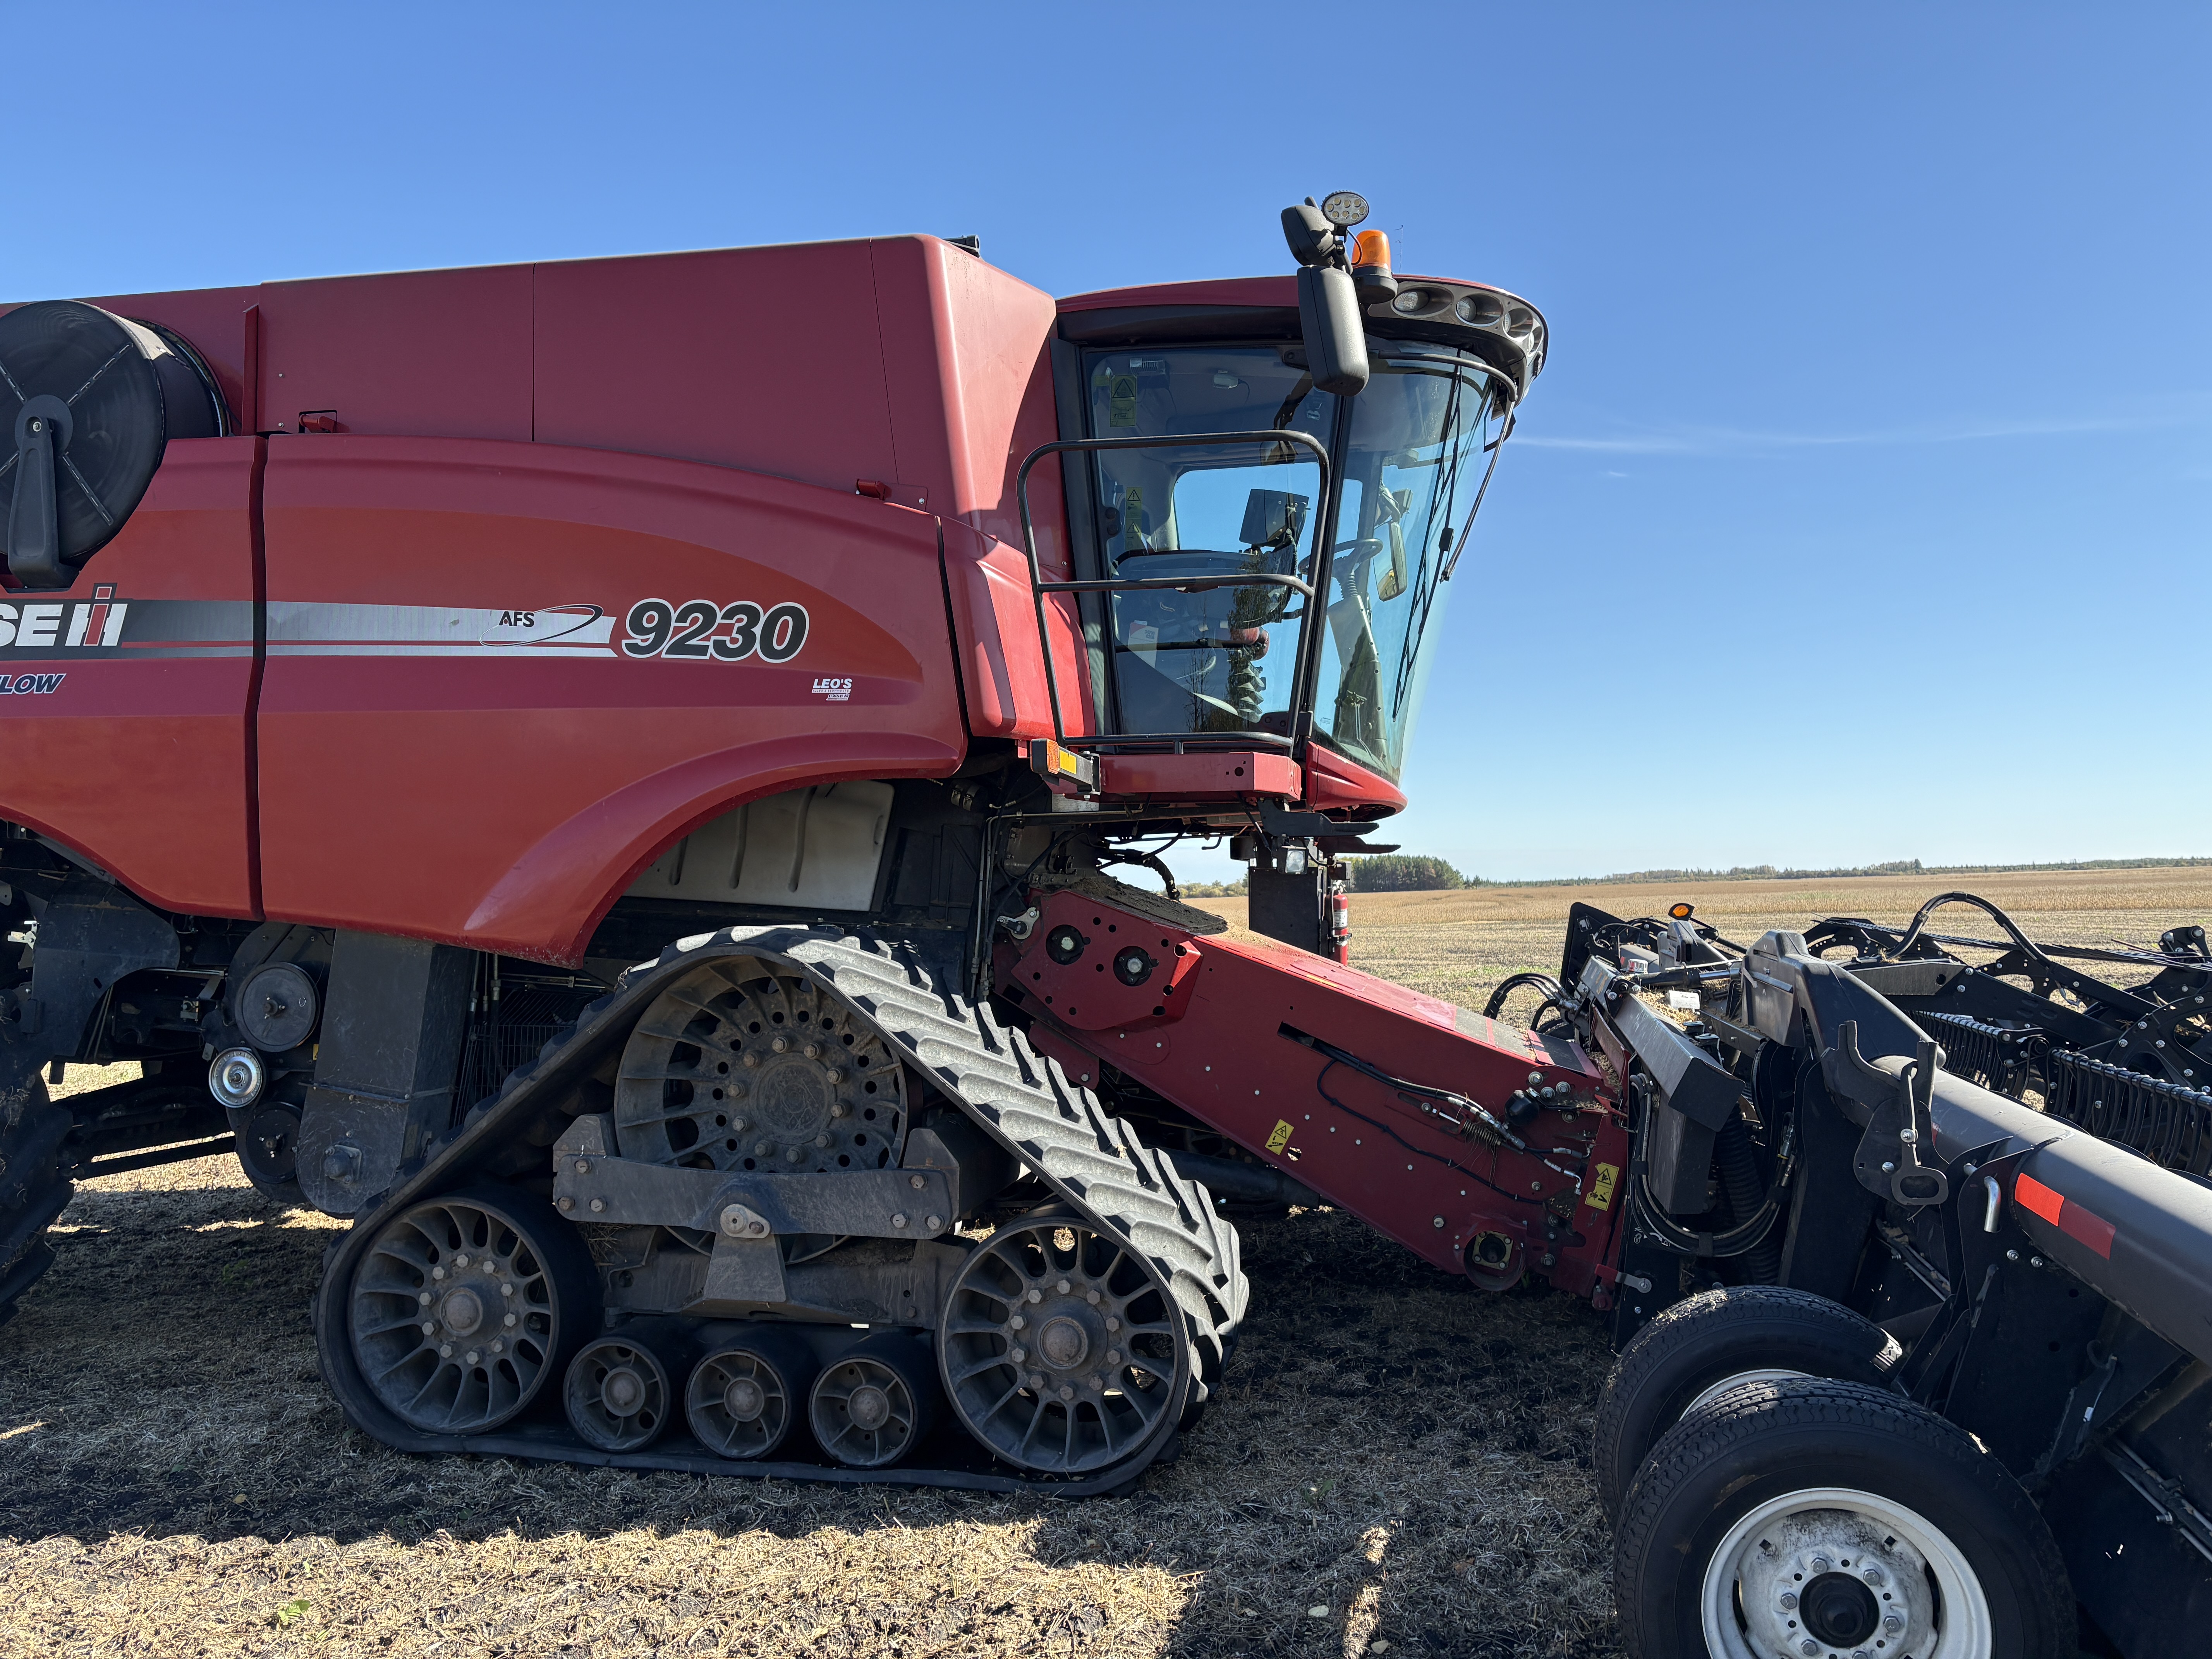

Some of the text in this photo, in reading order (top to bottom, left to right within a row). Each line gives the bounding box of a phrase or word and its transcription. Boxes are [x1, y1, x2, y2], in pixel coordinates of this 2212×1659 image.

[498, 611, 534, 627] AFS
[621, 598, 810, 663] 9230
[0, 673, 66, 694] LOW
[812, 678, 853, 689] LEO'S
